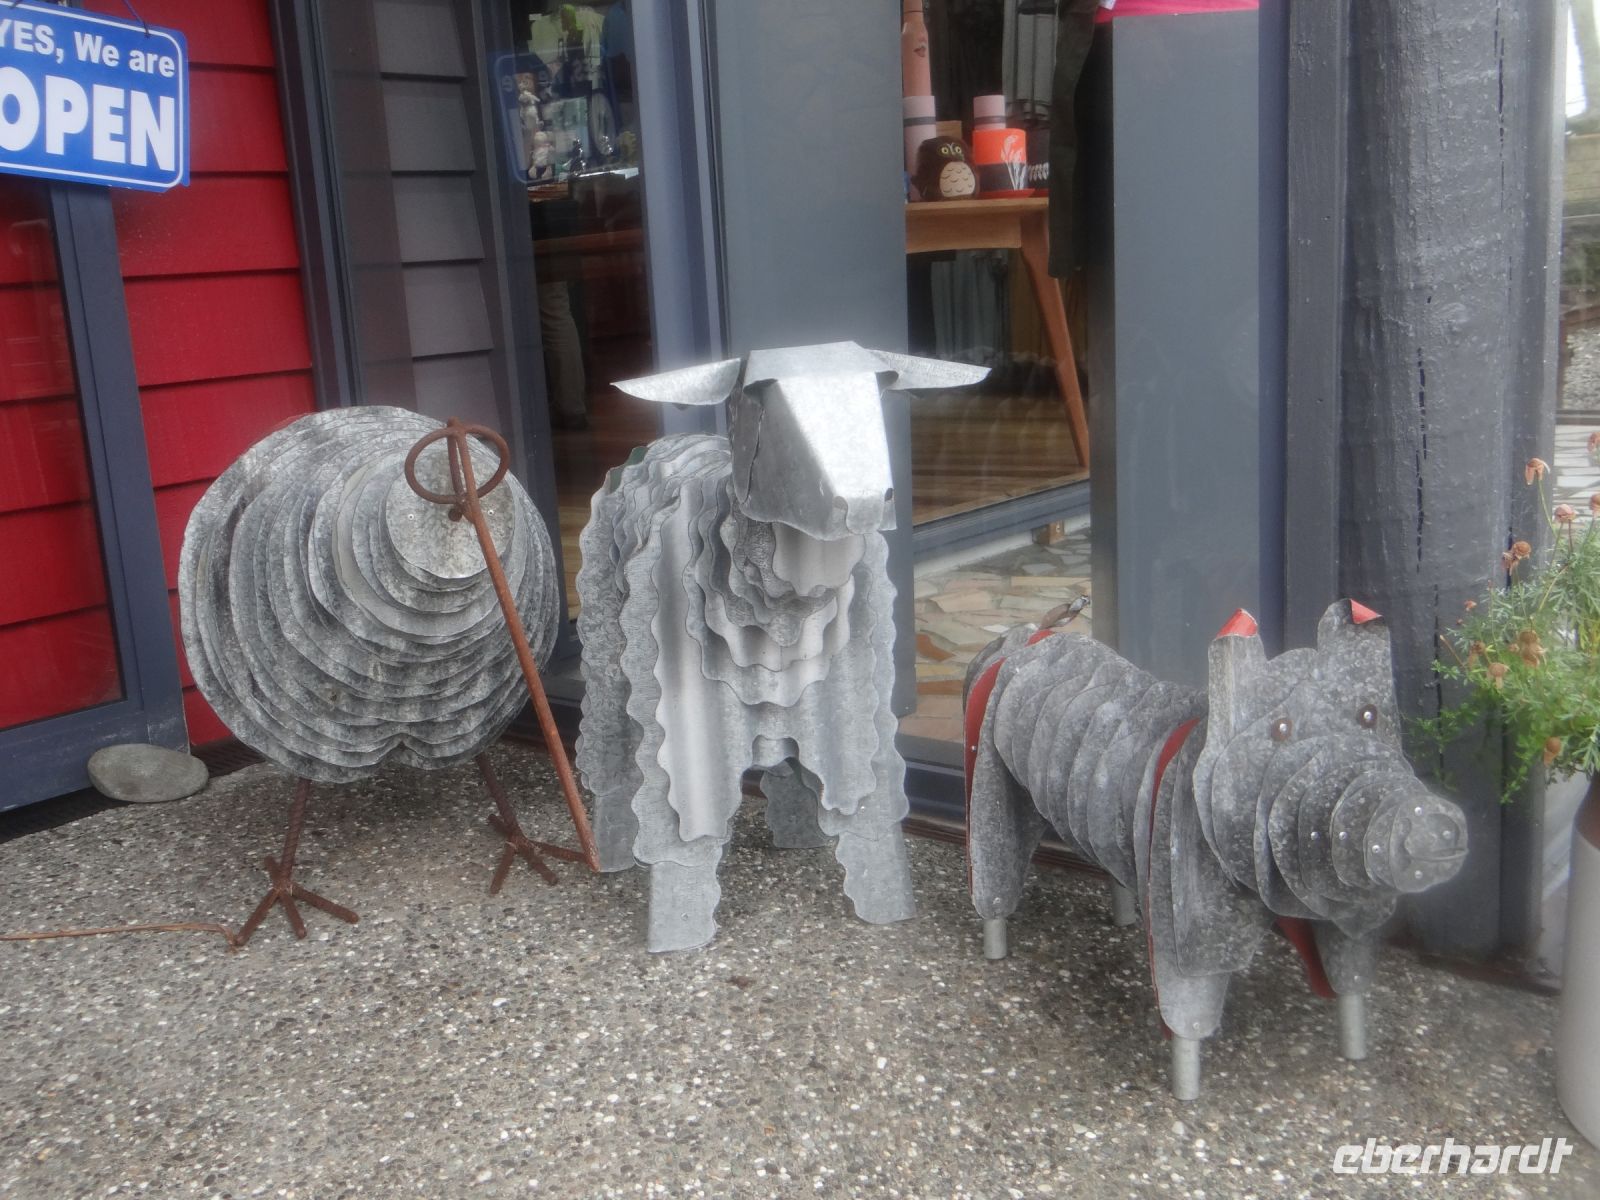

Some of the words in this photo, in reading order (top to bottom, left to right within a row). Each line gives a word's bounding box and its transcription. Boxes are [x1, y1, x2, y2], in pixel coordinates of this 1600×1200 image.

[74, 31, 119, 67] We
[129, 49, 175, 78] are
[0, 66, 175, 171] OPEN
